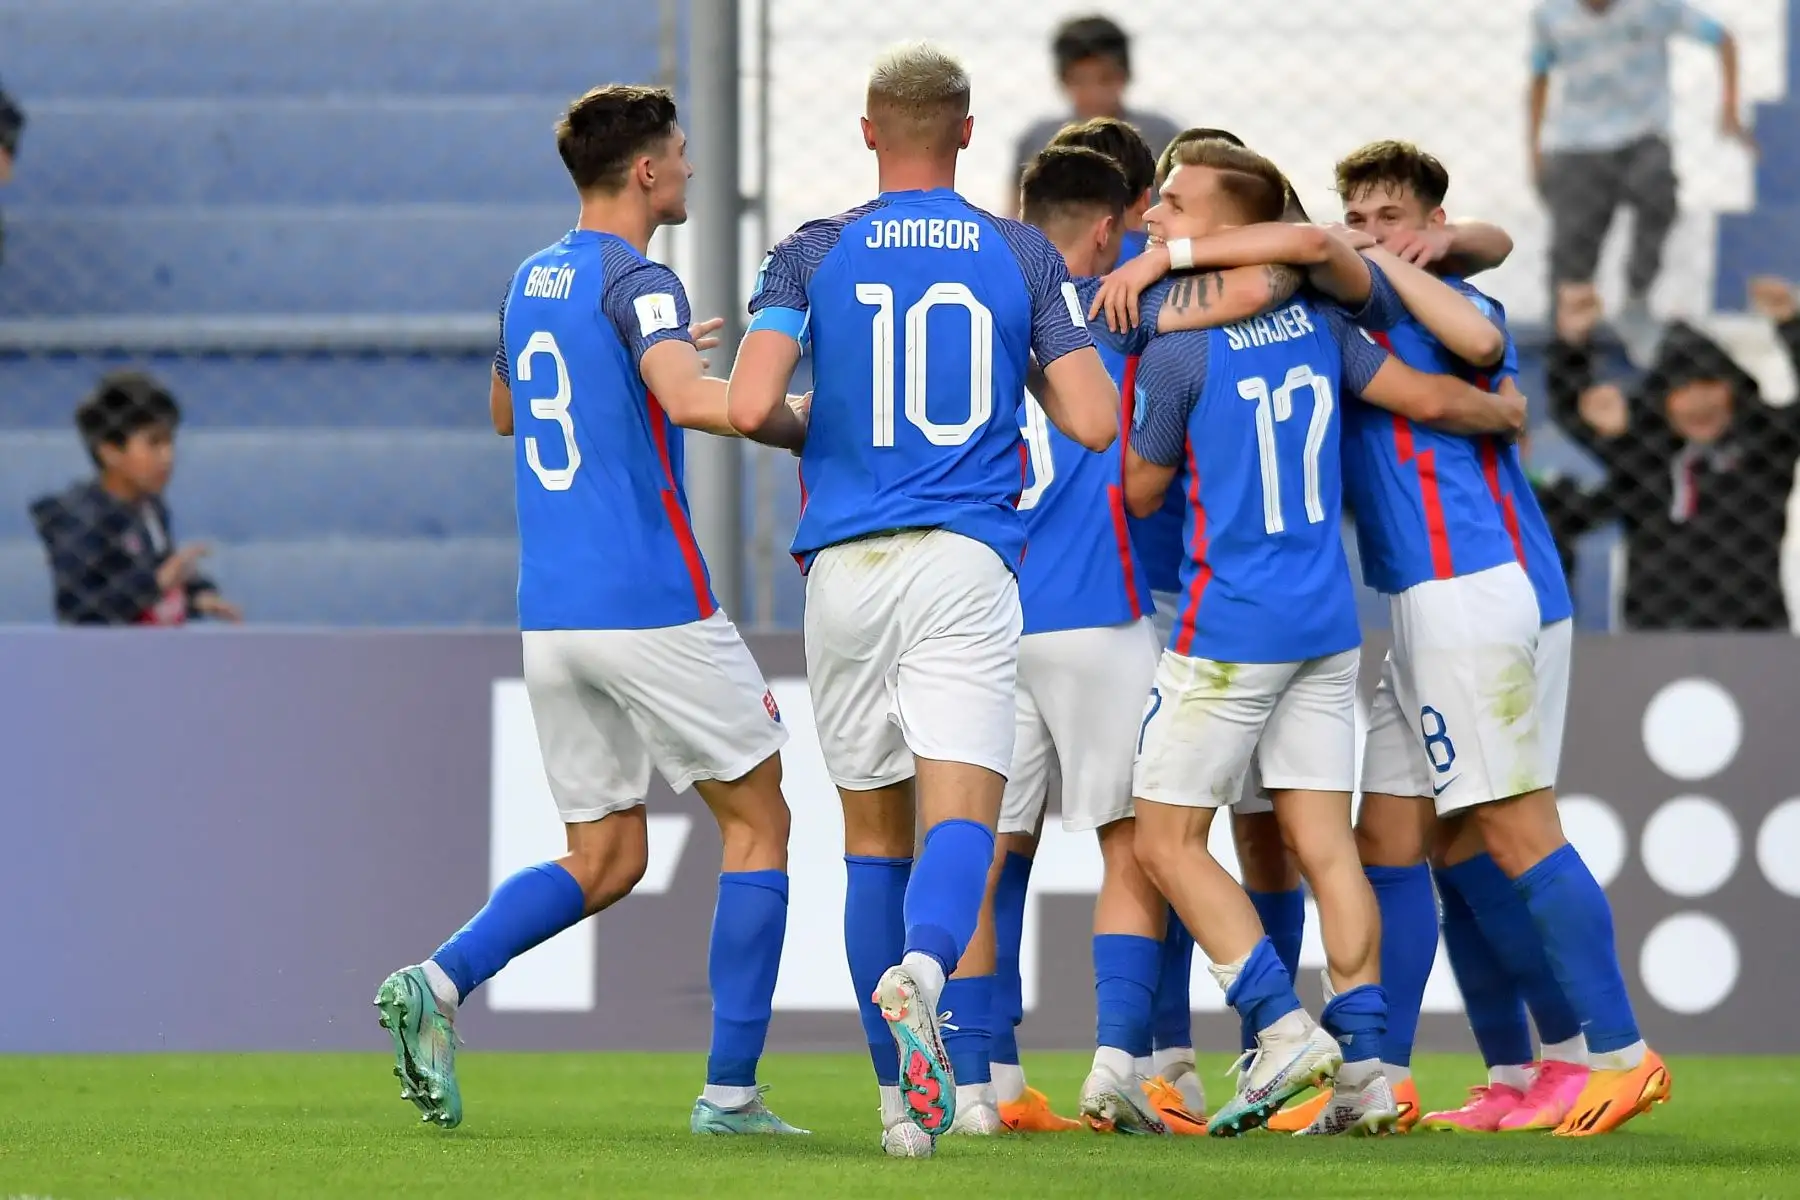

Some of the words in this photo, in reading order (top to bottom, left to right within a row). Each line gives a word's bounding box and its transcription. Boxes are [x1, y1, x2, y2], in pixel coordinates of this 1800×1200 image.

[524, 262, 576, 300] BAGÍN
[866, 219, 980, 252] JAMBOR
[517, 331, 581, 492] 3
[855, 282, 993, 448] 10
[1236, 364, 1334, 535] 17
[1420, 705, 1456, 774] 8
